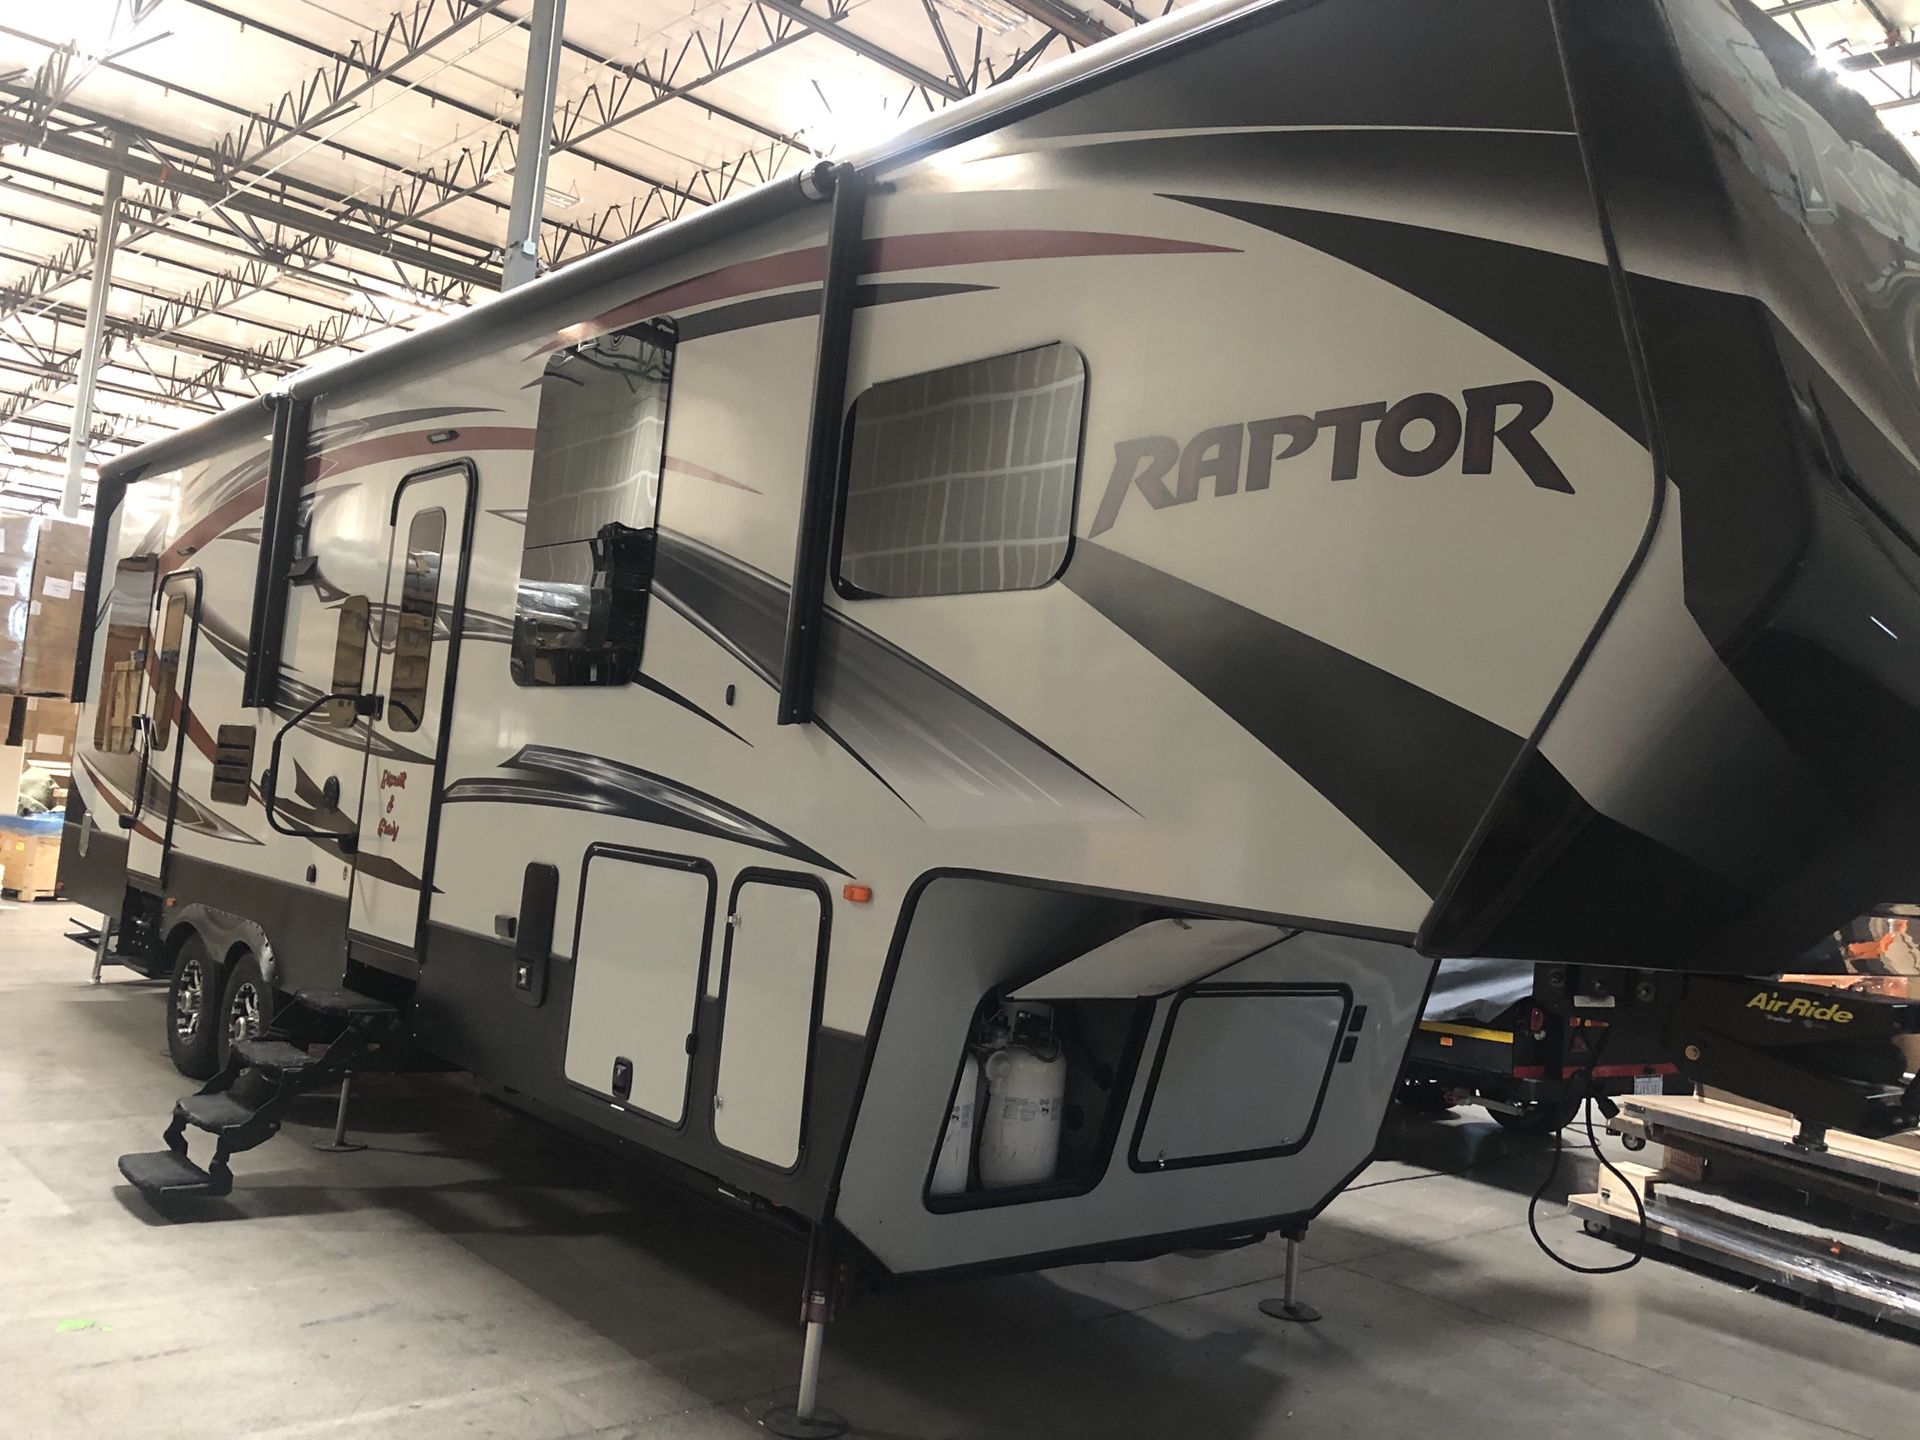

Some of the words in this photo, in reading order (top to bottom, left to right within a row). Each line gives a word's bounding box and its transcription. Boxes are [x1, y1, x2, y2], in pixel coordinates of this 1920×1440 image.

[1088, 380, 1577, 540] RAPTOR
[1745, 992, 1789, 1012] Air
[1786, 998, 1854, 1024] Ride
